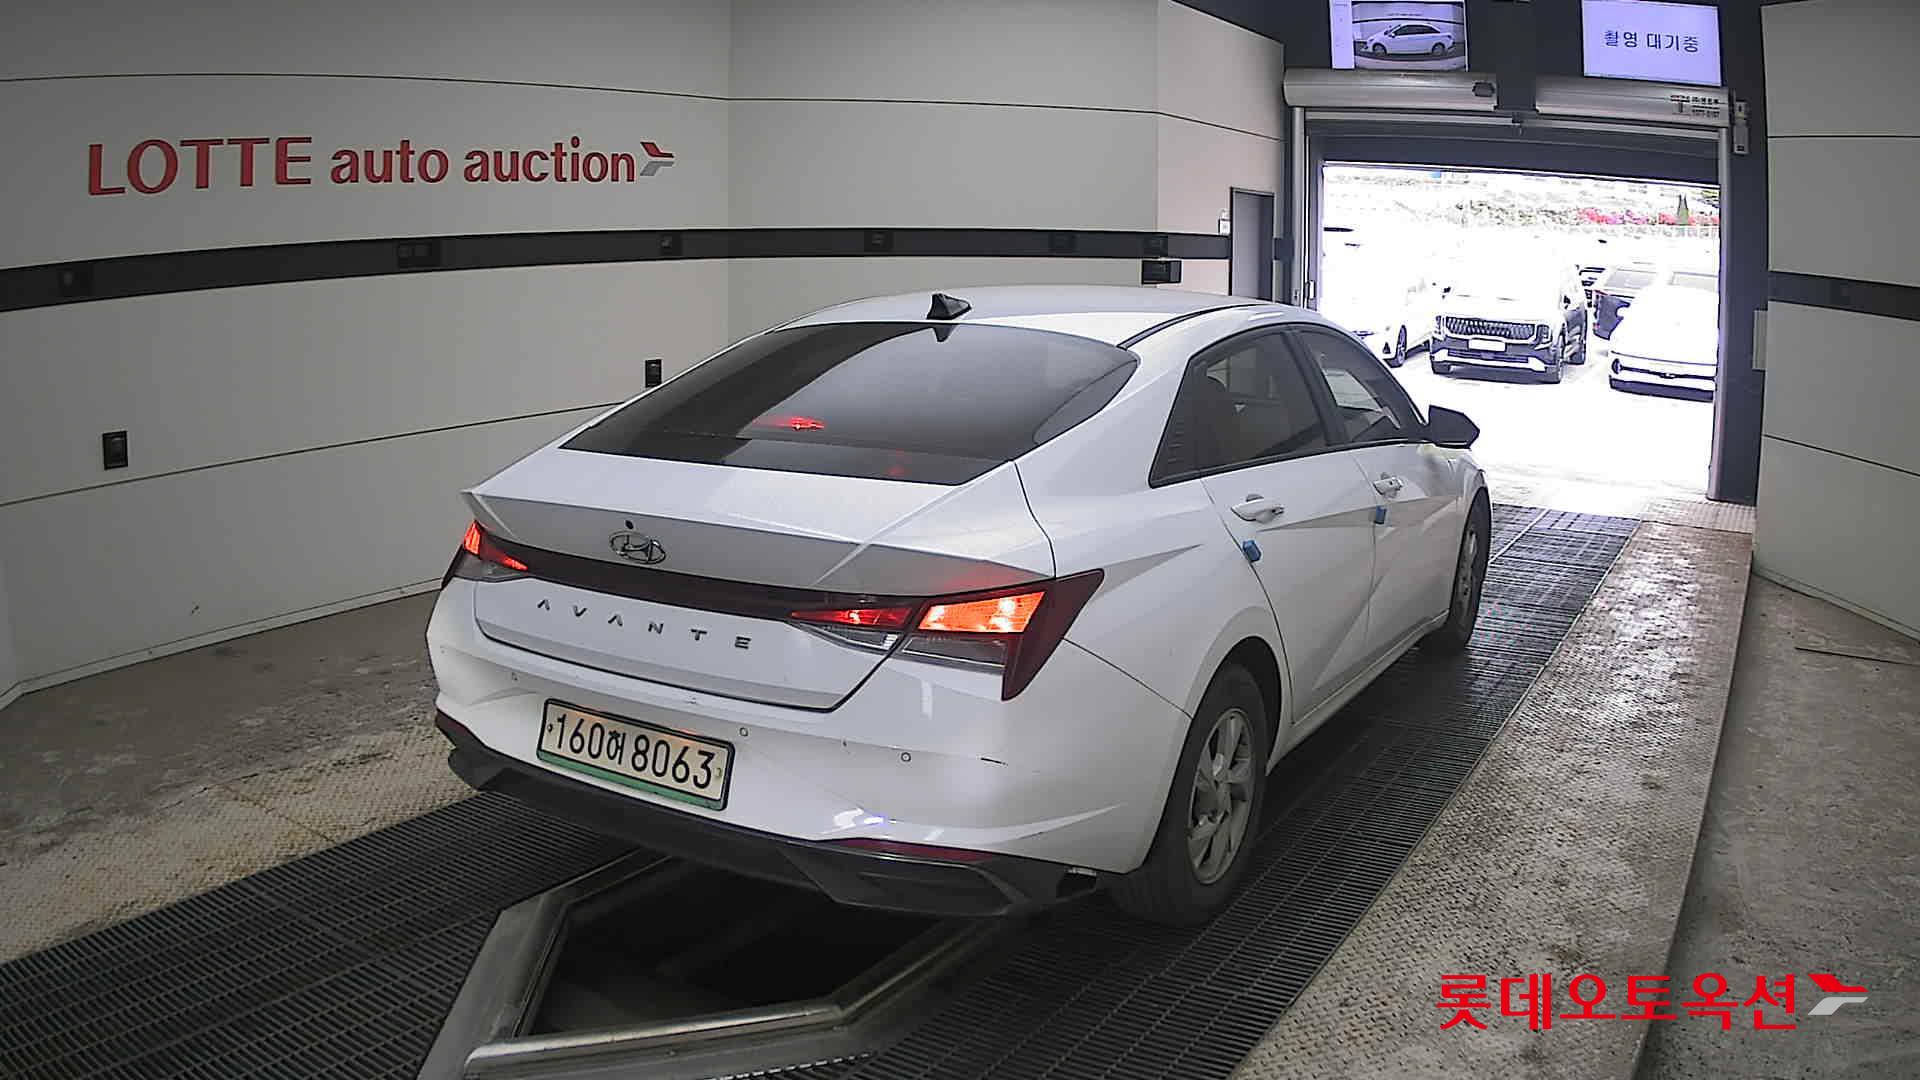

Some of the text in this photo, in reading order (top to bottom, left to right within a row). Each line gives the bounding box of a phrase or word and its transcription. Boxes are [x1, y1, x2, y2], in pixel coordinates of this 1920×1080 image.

[1646, 32, 1699, 53] 대기중
[88, 135, 636, 195] LOTTE auto auction
[537, 599, 752, 650] AVANTE
